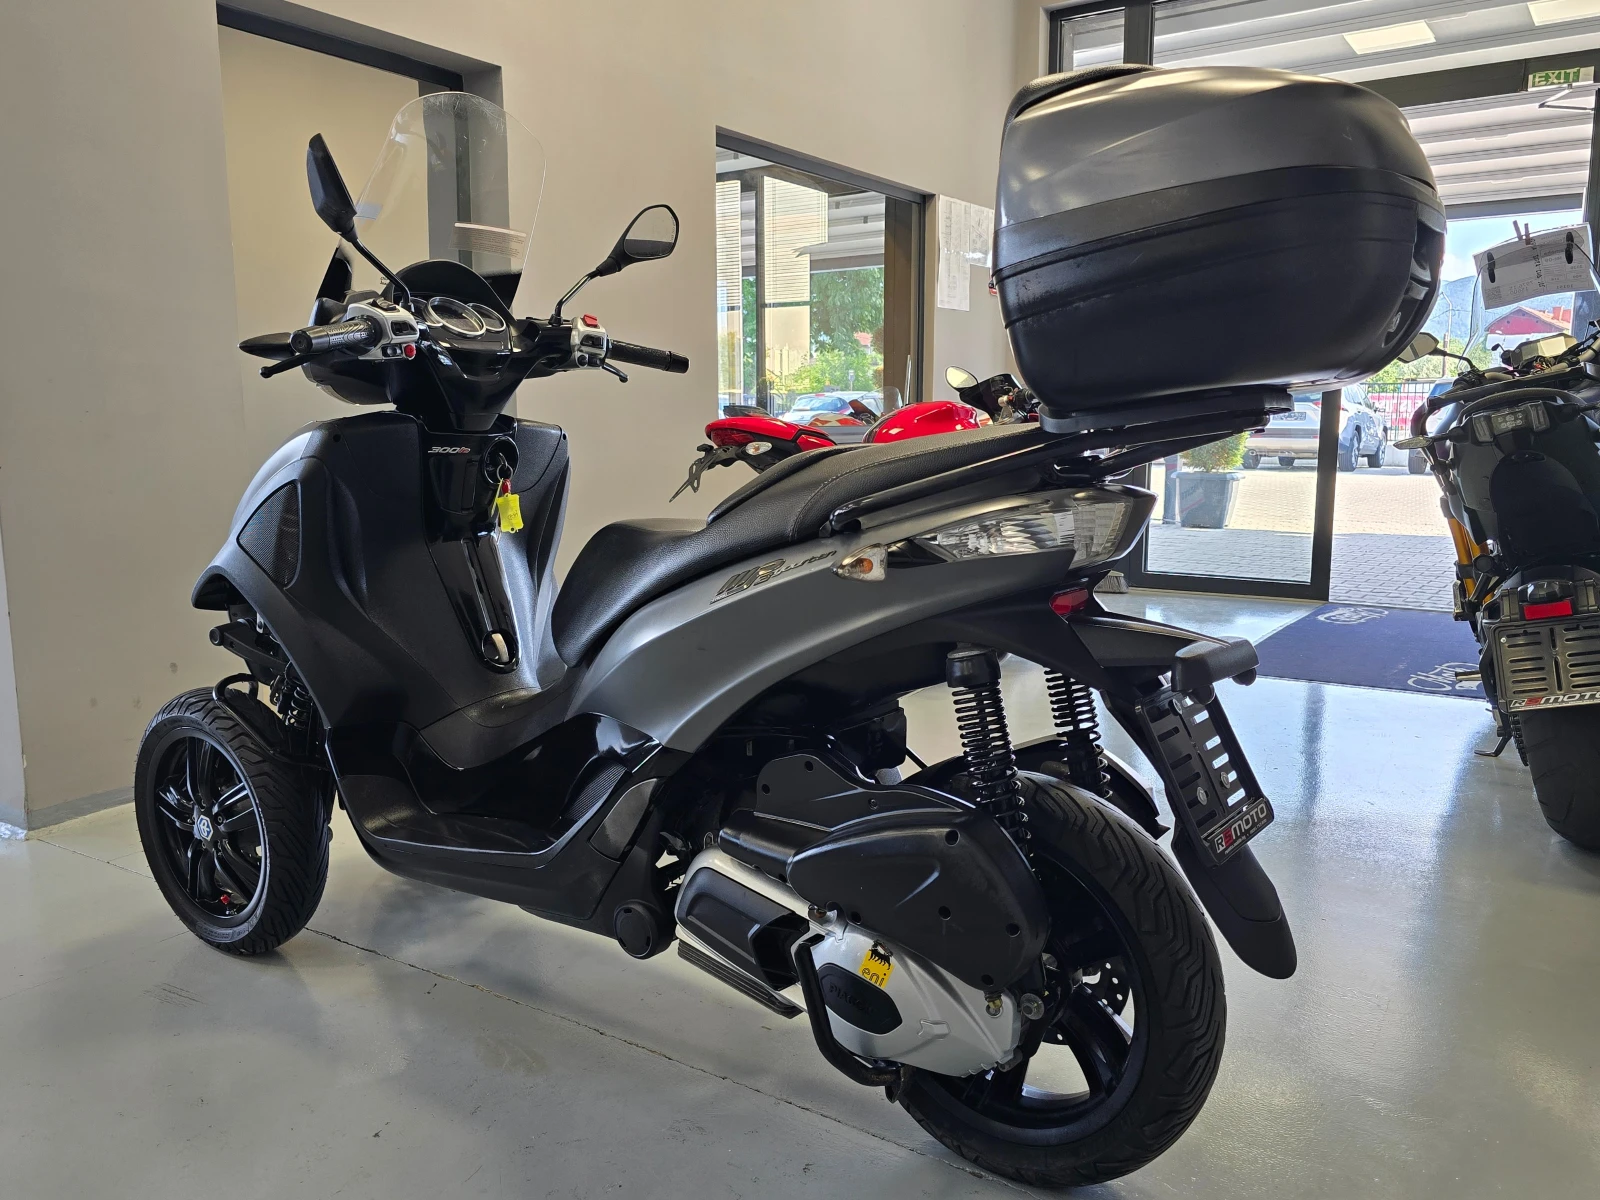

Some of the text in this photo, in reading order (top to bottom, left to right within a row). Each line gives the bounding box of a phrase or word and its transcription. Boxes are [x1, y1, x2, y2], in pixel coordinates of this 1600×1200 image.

[1534, 68, 1577, 87] EXIT
[1509, 691, 1600, 708] RSMOT
[1215, 803, 1267, 853] RSMOTO
[862, 967, 886, 987] eni
